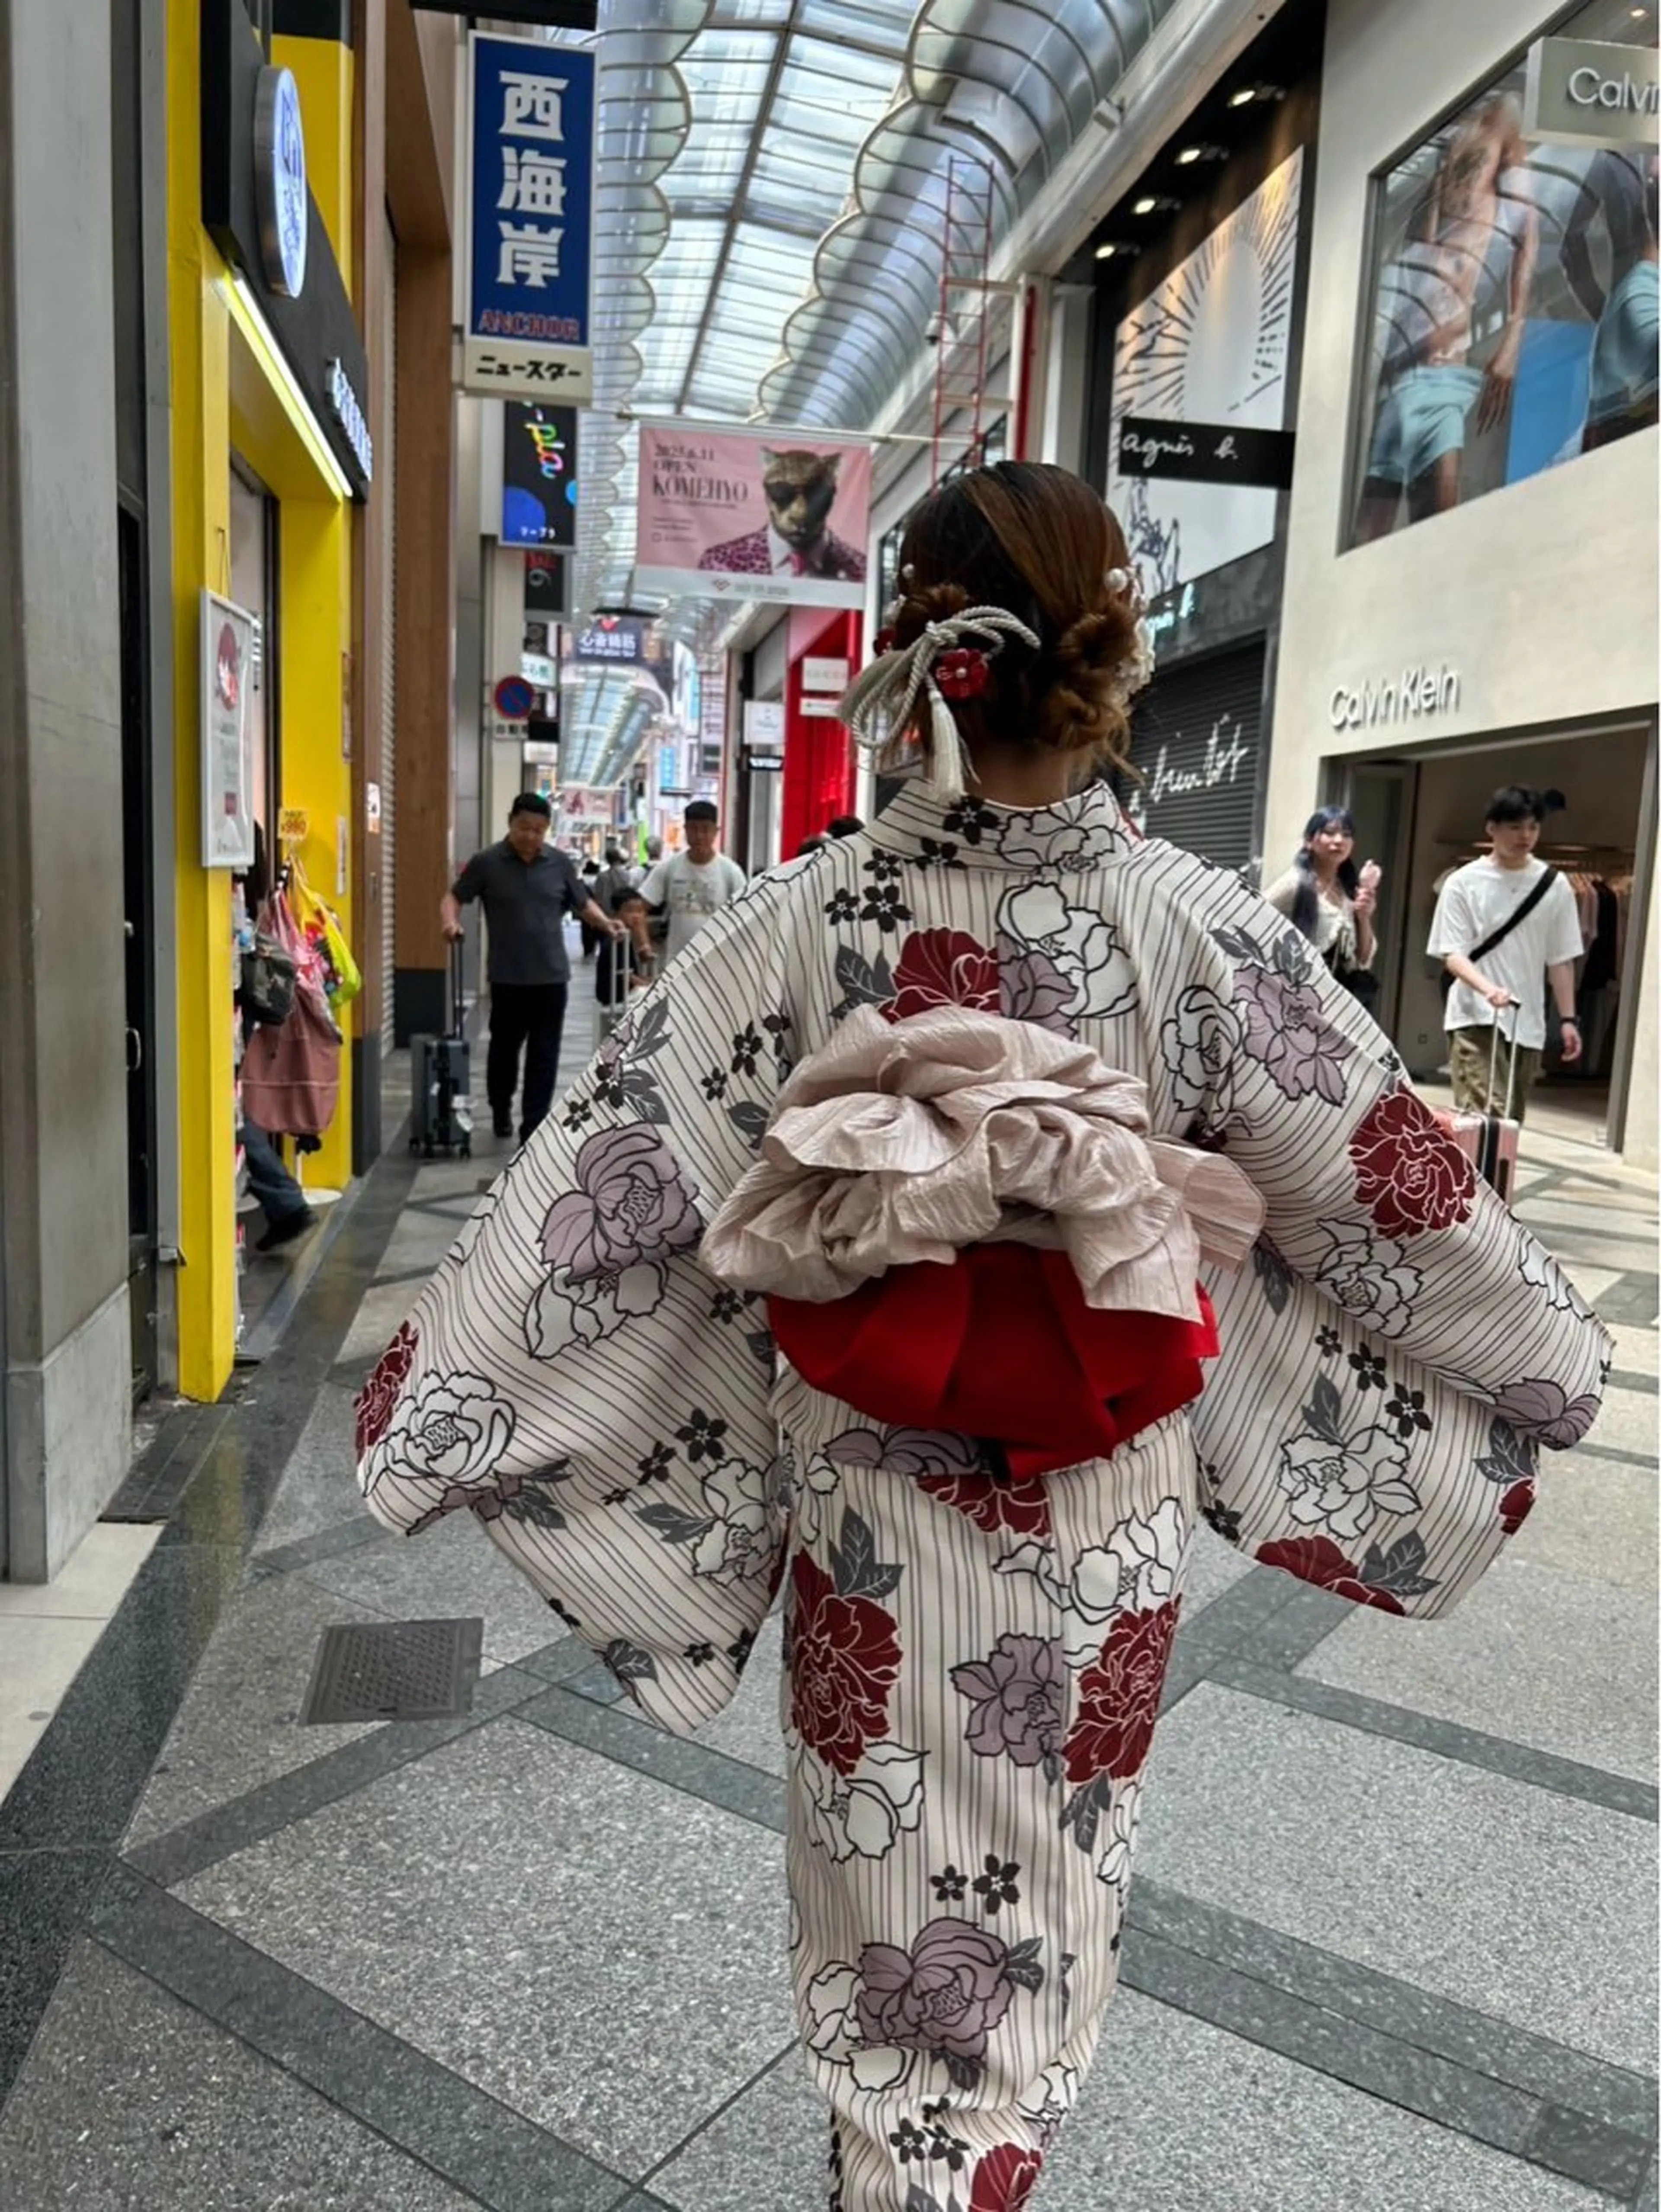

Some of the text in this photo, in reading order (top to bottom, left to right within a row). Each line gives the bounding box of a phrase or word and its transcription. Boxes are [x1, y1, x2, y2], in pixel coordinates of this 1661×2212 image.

[496, 70, 569, 288] 西海岸
[478, 308, 580, 341] ANCHOR
[476, 355, 582, 382] ニュースター
[653, 458, 696, 474] OPEN
[652, 474, 748, 501] KOMEHYO
